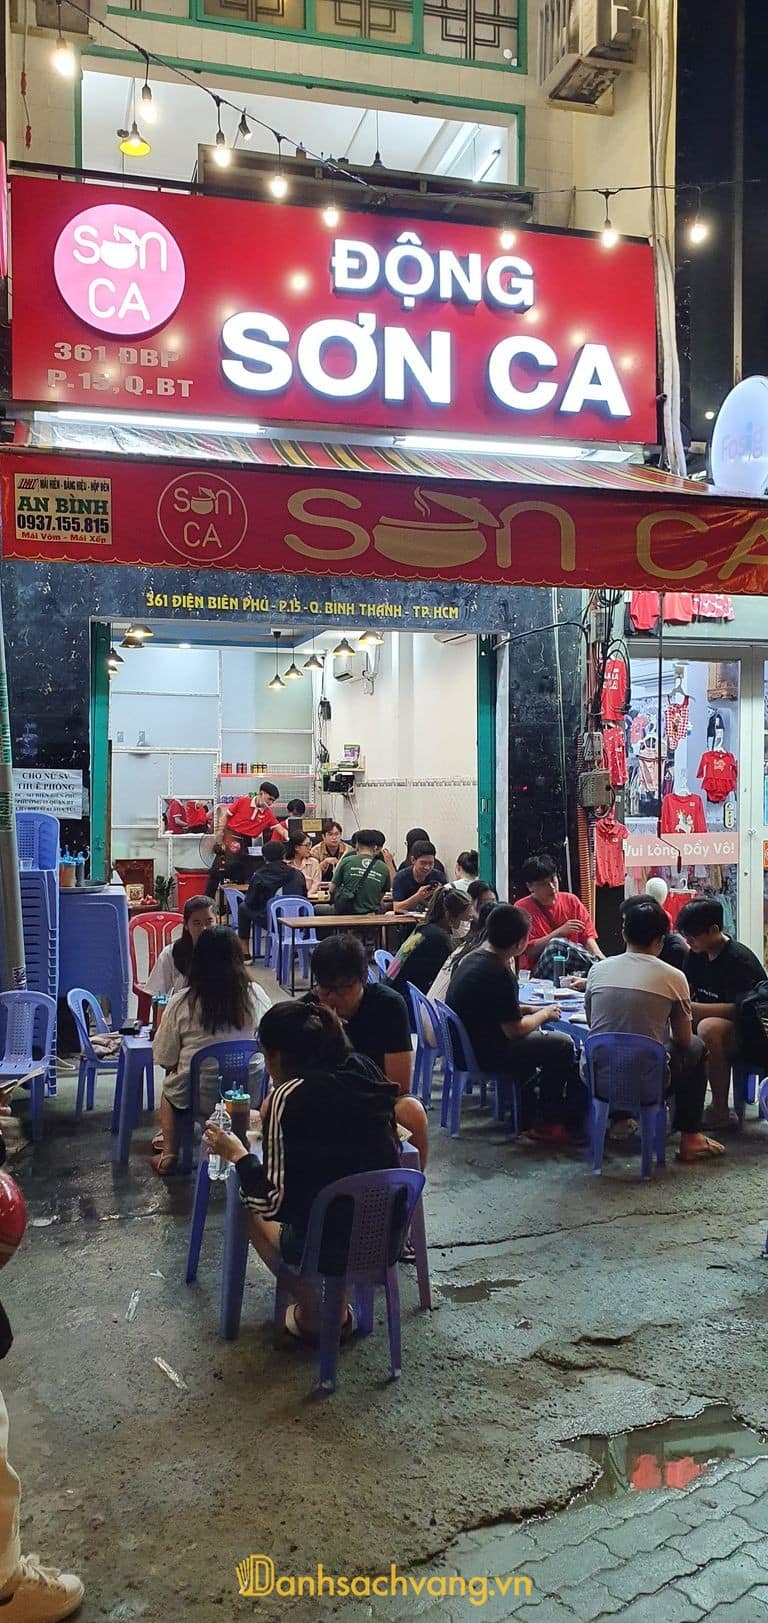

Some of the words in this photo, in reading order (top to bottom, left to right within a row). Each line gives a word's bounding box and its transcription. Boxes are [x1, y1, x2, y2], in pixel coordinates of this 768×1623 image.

[330, 231, 536, 310] ĐỘNG
[88, 277, 150, 321] CA
[54, 342, 107, 363] 361
[118, 347, 180, 368] ĐBP
[220, 311, 452, 405] SƠN
[487, 335, 633, 418] CA
[17, 495, 50, 513] AN
[55, 493, 109, 515] BÌNH
[16, 513, 110, 534] 0937.155.815
[183, 521, 222, 549] CA
[21, 531, 38, 540] Mái
[40, 532, 61, 541] Vòm
[146, 593, 169, 607] 361
[172, 592, 204, 611] ĐIỆN
[207, 594, 239, 610] BIÊN
[242, 595, 269, 612] PHỦ
[279, 598, 301, 612] P.15
[309, 600, 322, 614] Q.
[359, 602, 402, 619] THẠNH
[412, 605, 459, 619] TP.HCM
[18, 781, 43, 791] THUÊ
[43, 782, 75, 791] PHÒNG
[22, 772, 42, 780] CHO
[712, 841, 735, 855] Vô!
